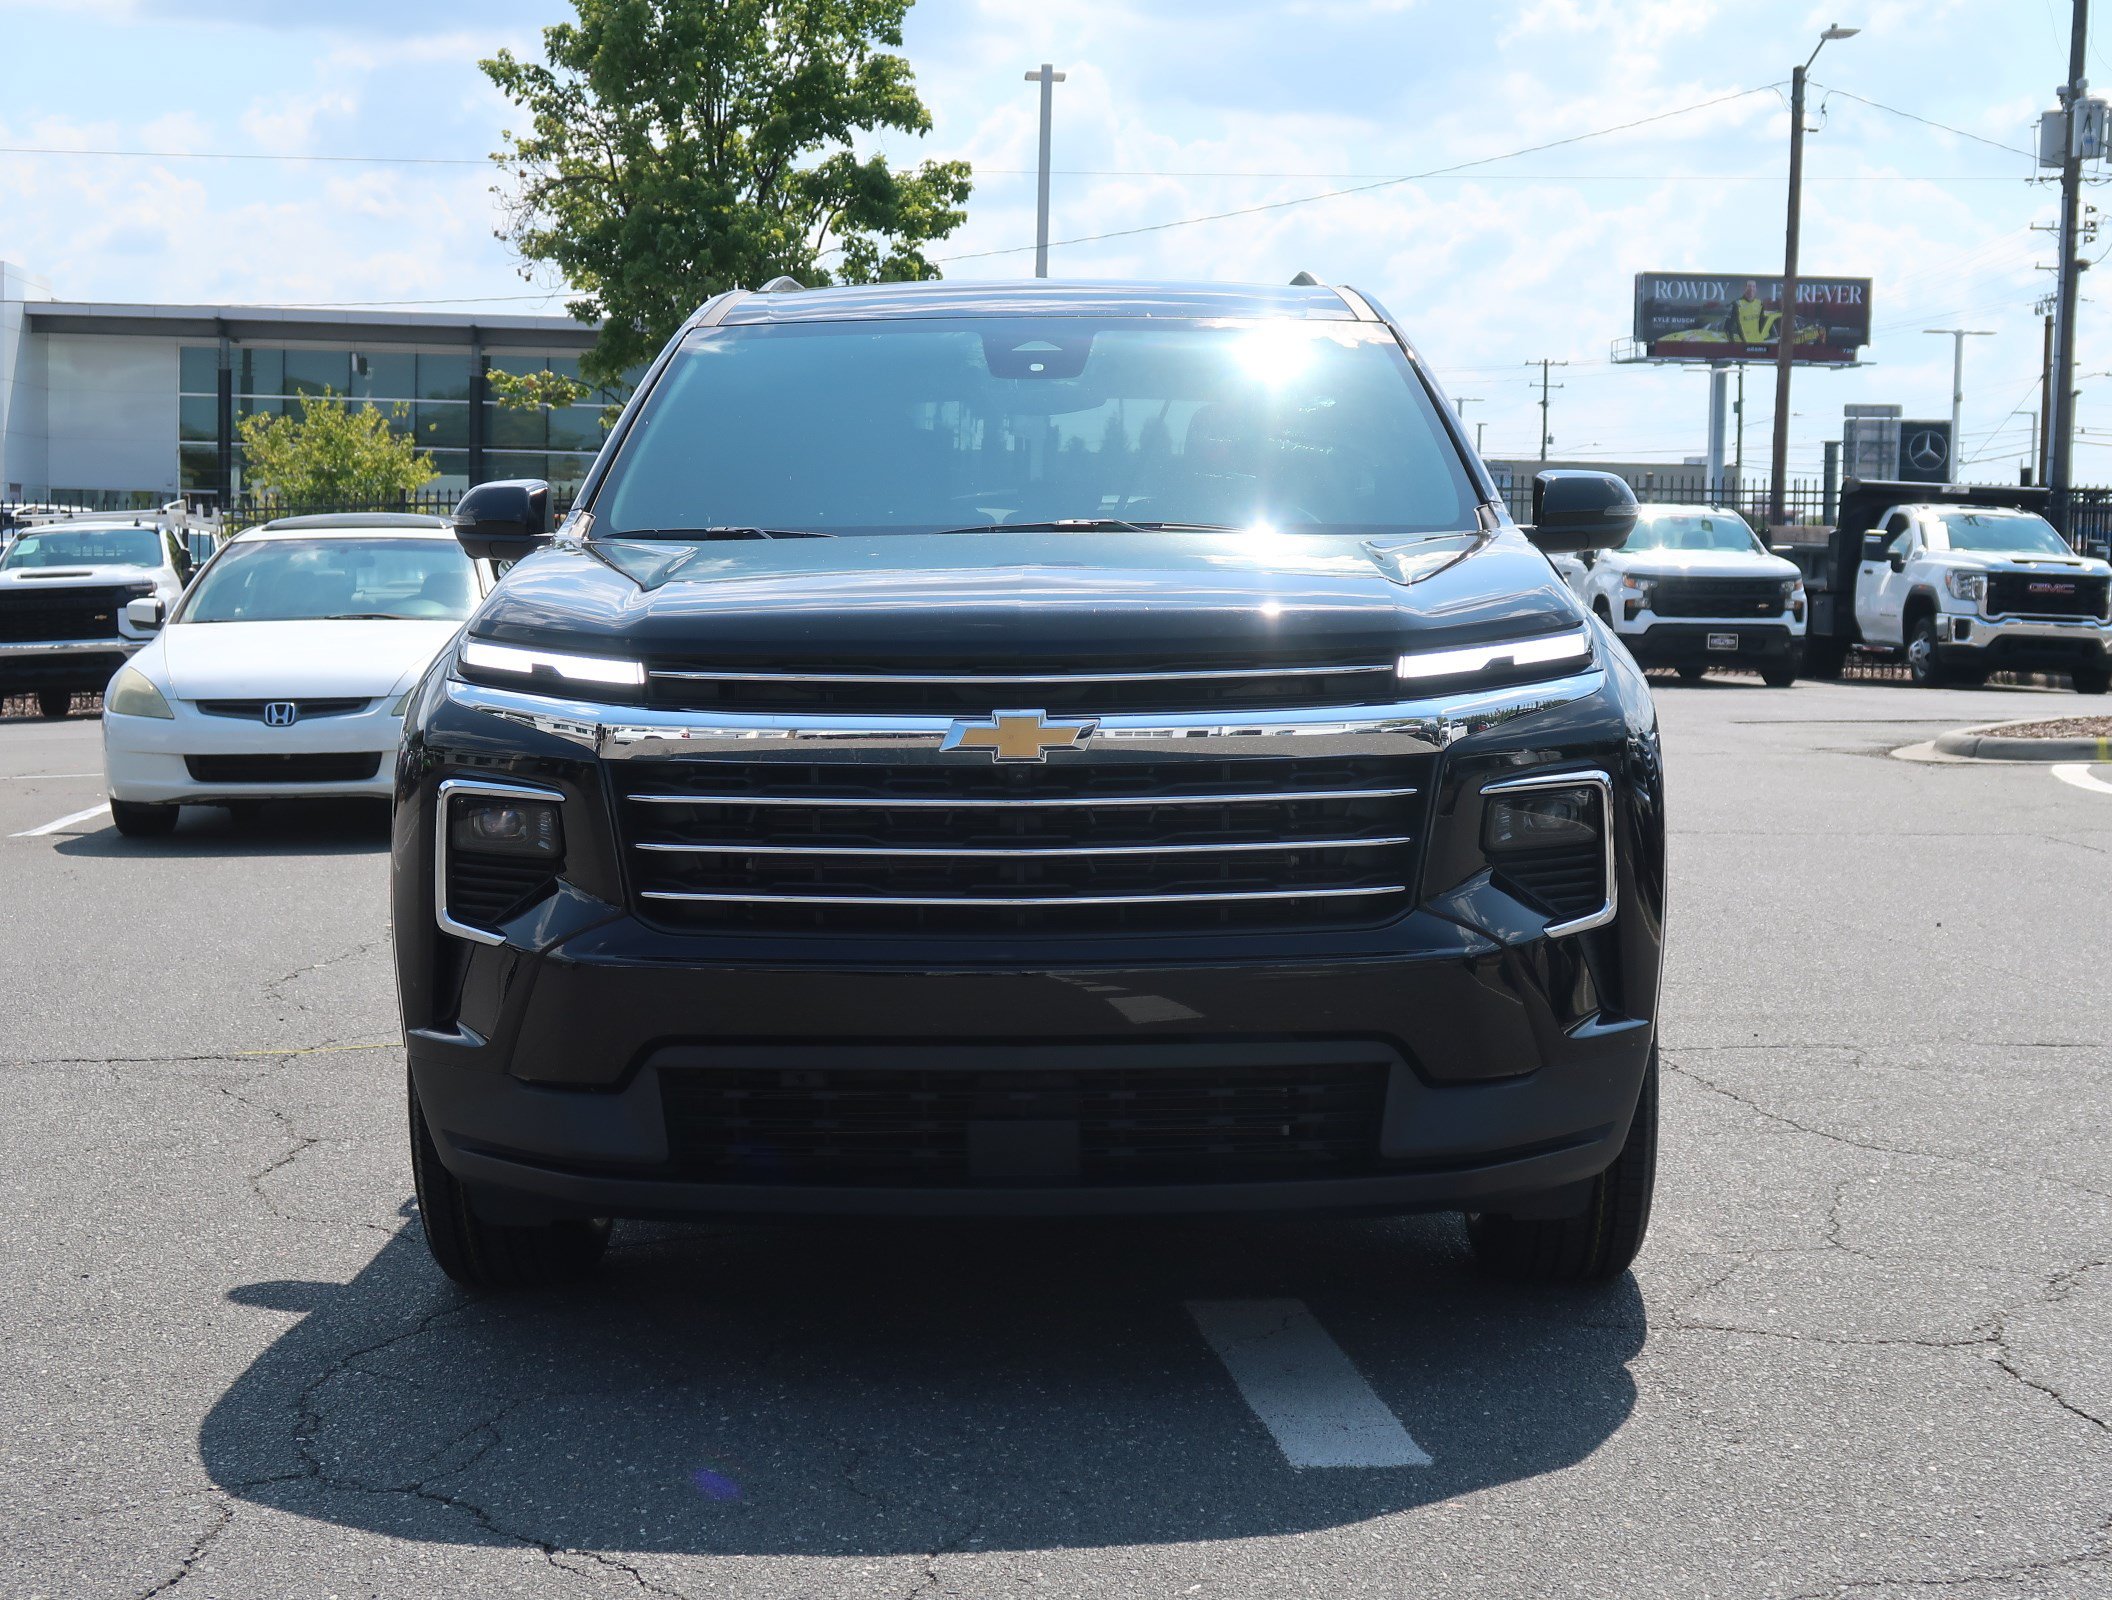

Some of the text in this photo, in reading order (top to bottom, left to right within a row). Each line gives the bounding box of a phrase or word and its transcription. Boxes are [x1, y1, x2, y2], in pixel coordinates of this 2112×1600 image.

[1655, 280, 1862, 304] ROWDY FREVER
[2029, 582, 2075, 594] GMC
